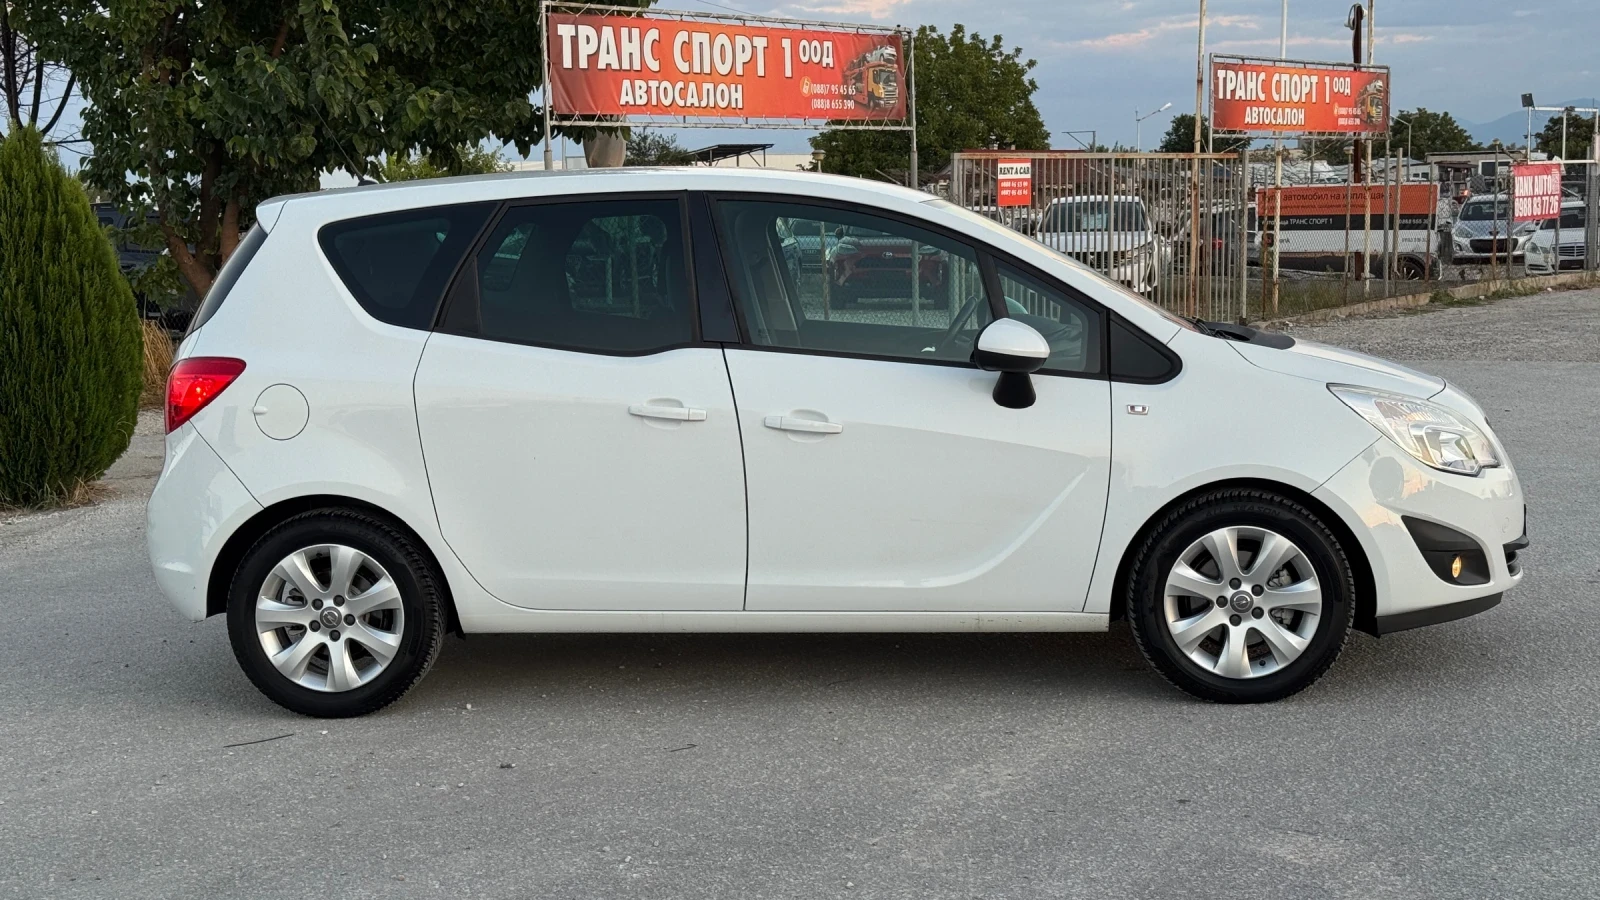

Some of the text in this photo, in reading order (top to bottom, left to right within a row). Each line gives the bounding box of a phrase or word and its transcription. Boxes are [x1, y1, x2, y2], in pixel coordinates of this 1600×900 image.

[557, 24, 834, 78] ТРАНС СПОРТ 1 ООД
[619, 79, 743, 109] АВТОСАЛОН
[831, 84, 839, 95] 95
[840, 85, 848, 95] 45
[848, 85, 856, 95] 65
[1217, 69, 1351, 104] ТРАНС СПОРТ 1 ООД
[831, 99, 843, 109] 655
[843, 100, 855, 110] 390
[1244, 106, 1305, 126] АВТОСАЛОН
[999, 166, 1030, 175] RENT A CAR
[1534, 175, 1552, 195] AUTO
[1283, 191, 1328, 201] автомобил
[1542, 196, 1549, 215] 77
[1550, 195, 1558, 214] 26
